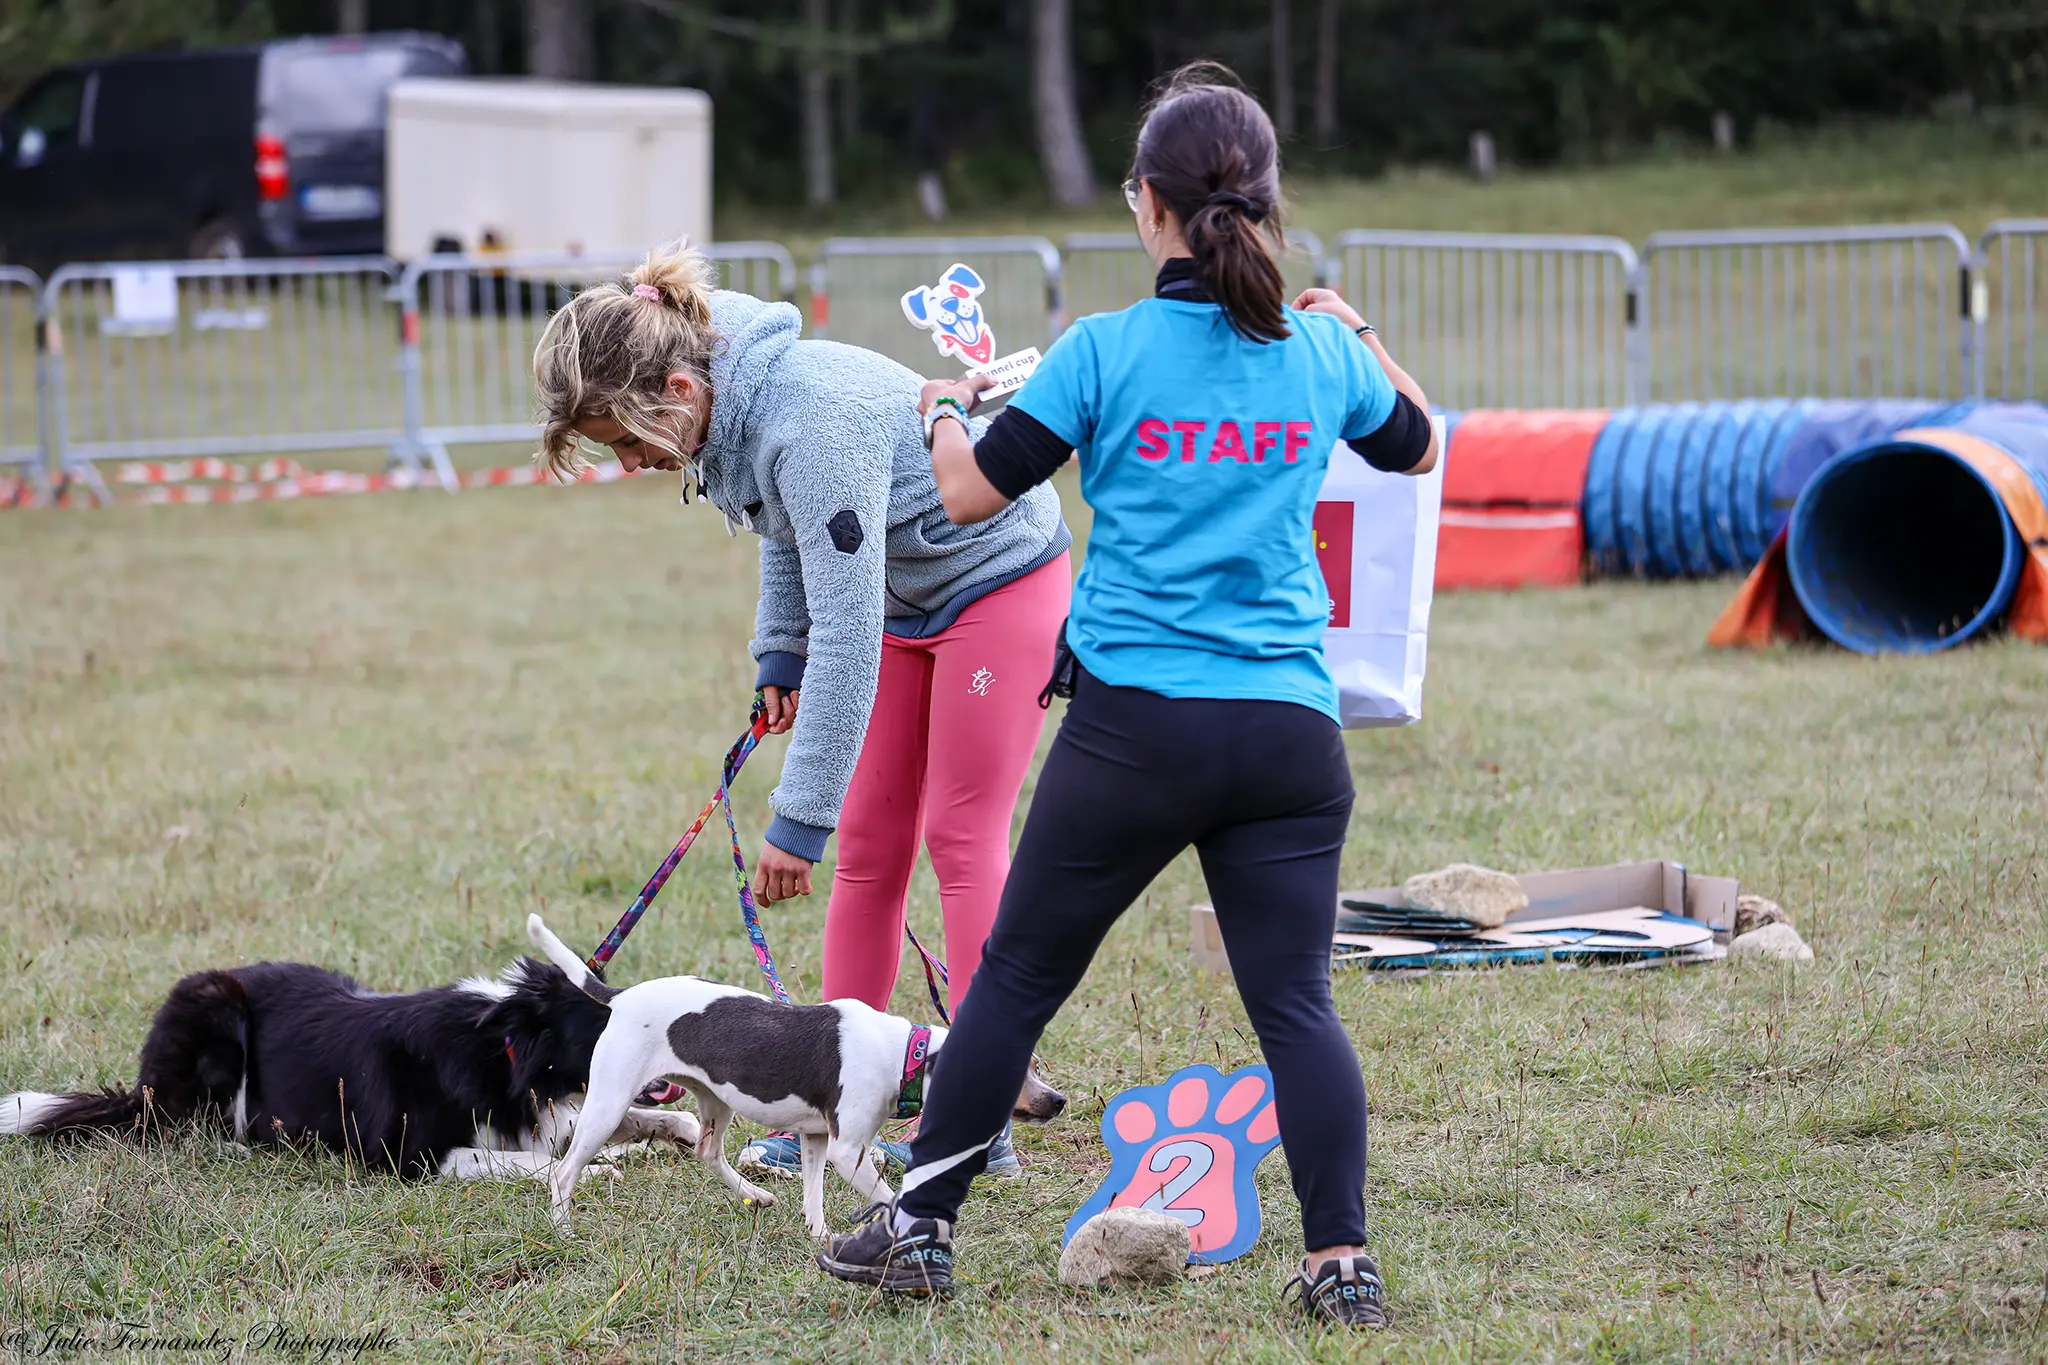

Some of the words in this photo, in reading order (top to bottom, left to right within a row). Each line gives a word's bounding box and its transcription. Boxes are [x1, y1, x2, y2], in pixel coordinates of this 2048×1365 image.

[1015, 355, 1036, 367] cup
[1136, 418, 1312, 463] STAFF
[1139, 1140, 1214, 1228] 2
